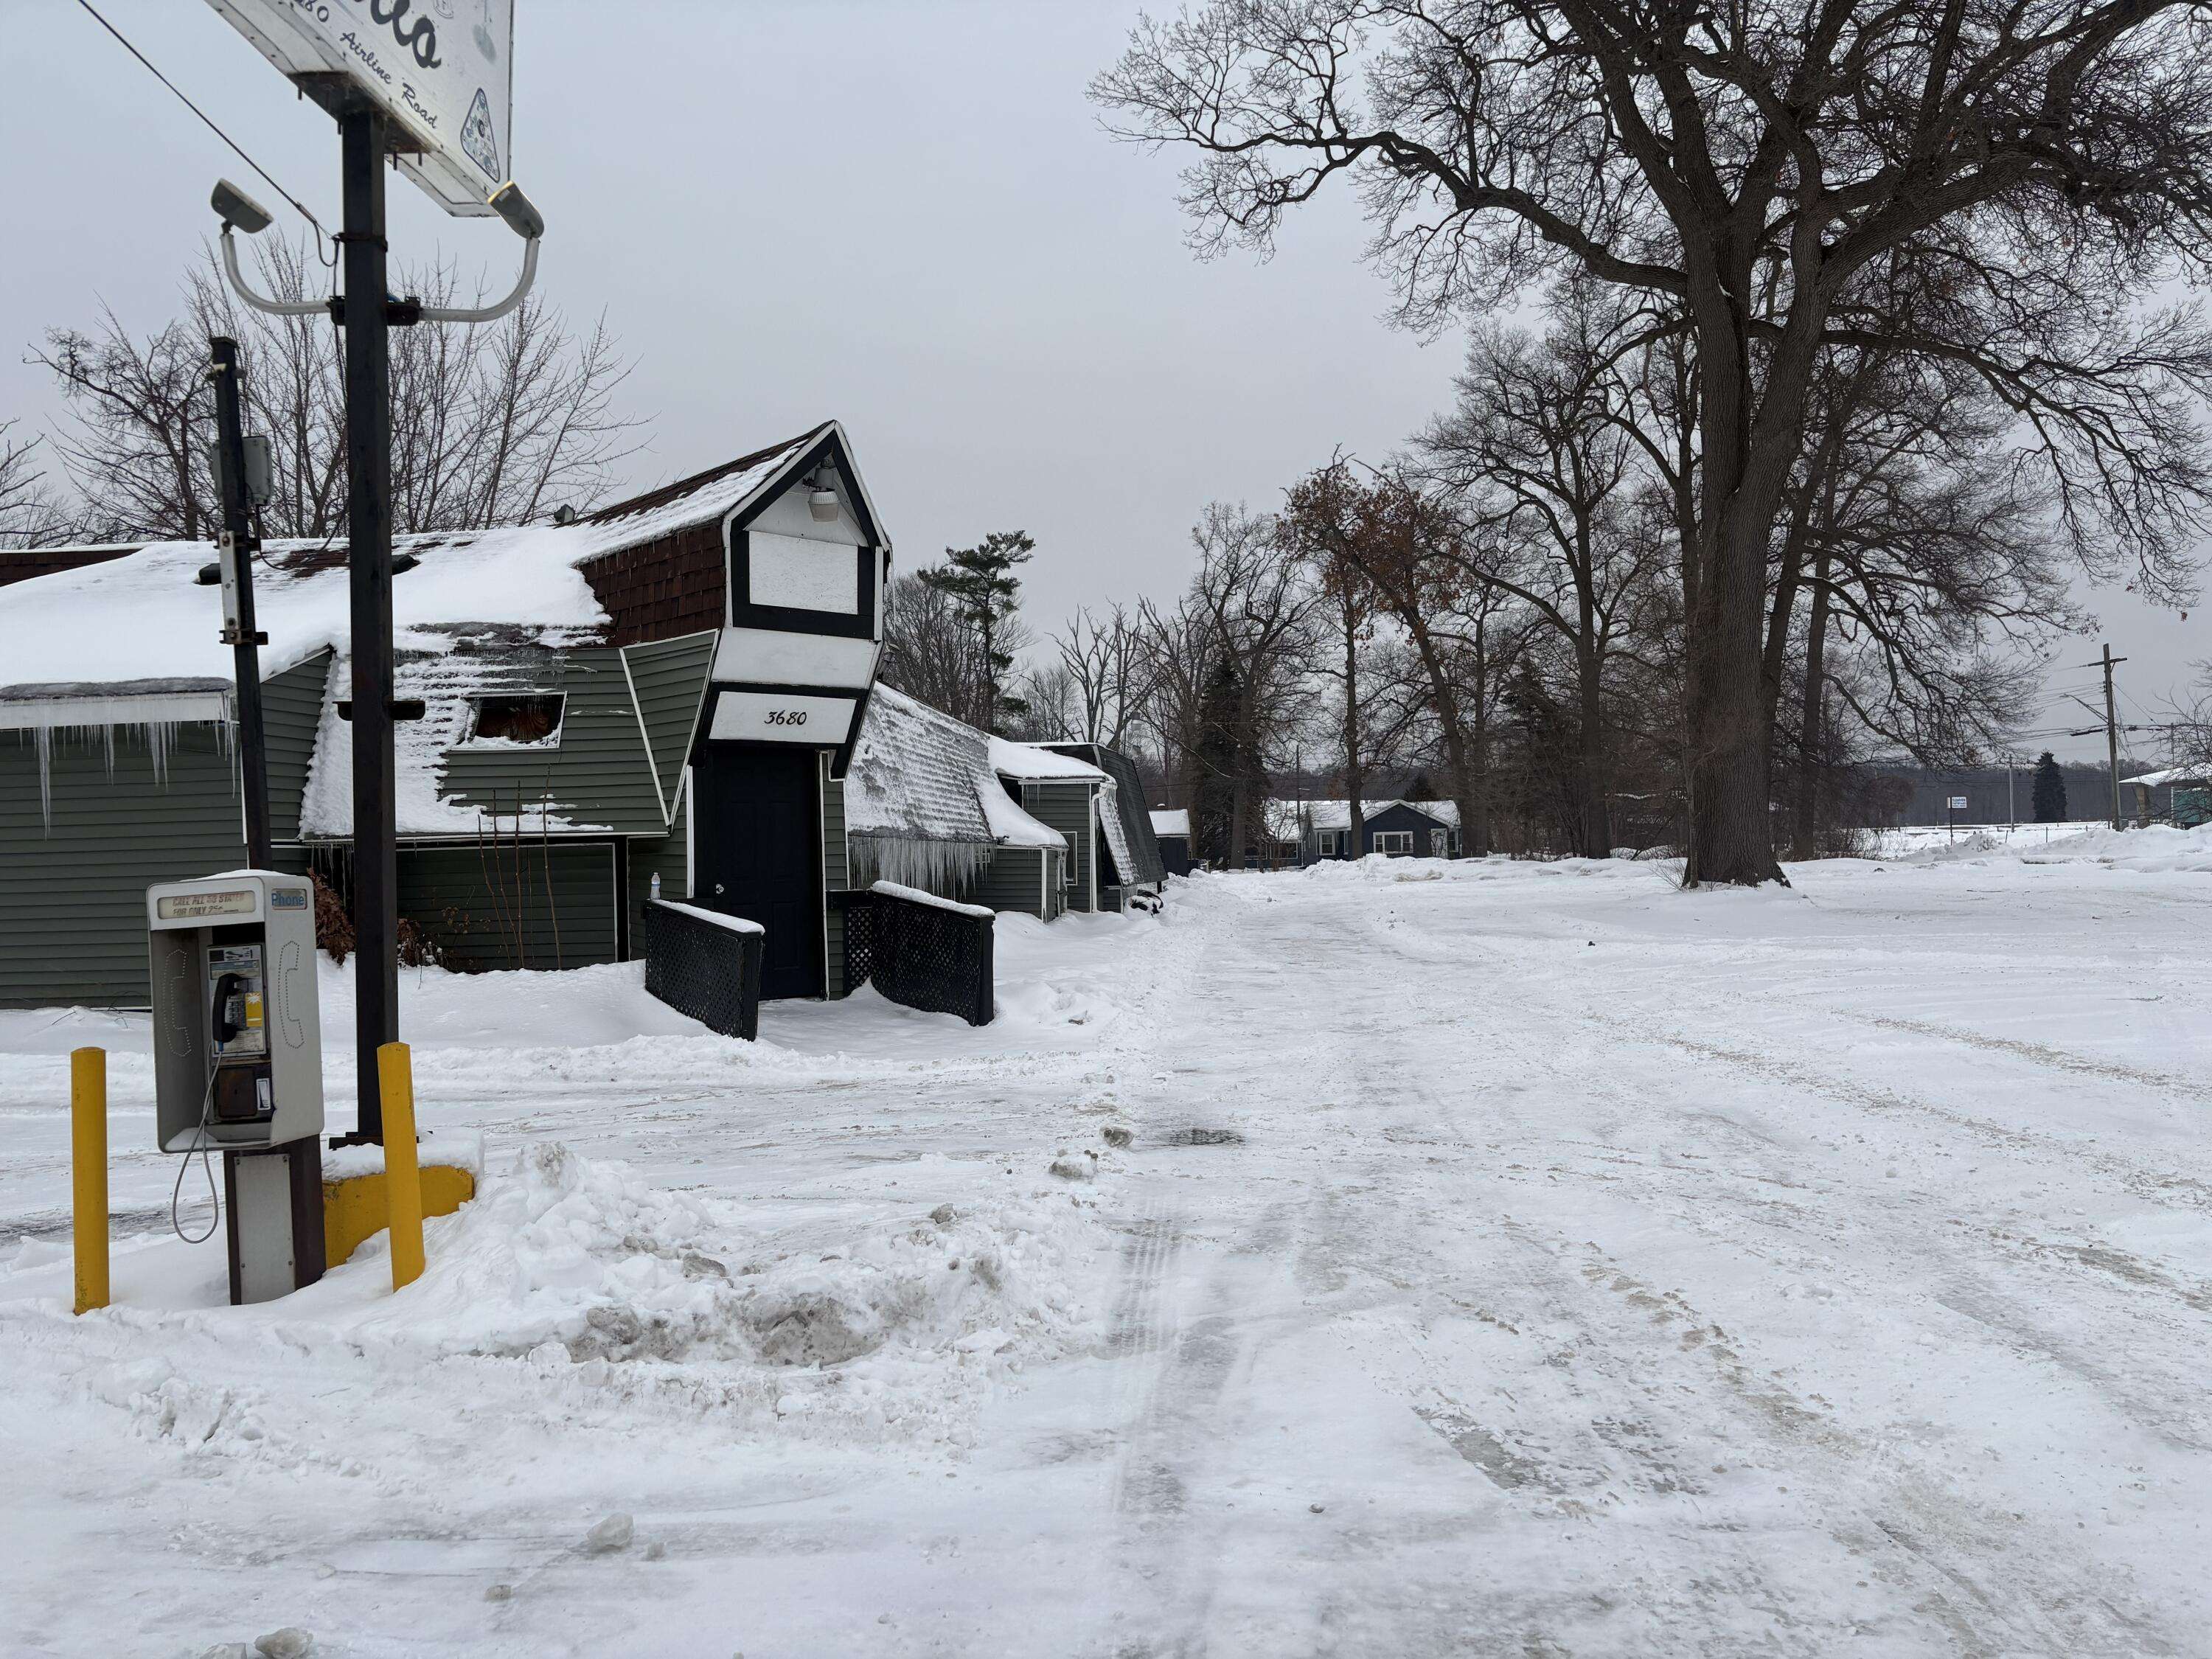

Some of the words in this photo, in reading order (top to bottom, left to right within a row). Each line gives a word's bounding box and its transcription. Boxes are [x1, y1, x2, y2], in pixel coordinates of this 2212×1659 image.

[339, 32, 392, 85] Airline
[402, 81, 437, 129] Road
[764, 710, 807, 726] 3680
[192, 896, 204, 905] ALL
[271, 892, 305, 905] Phone
[173, 908, 187, 916] FOR
[189, 905, 207, 915] ONLY
